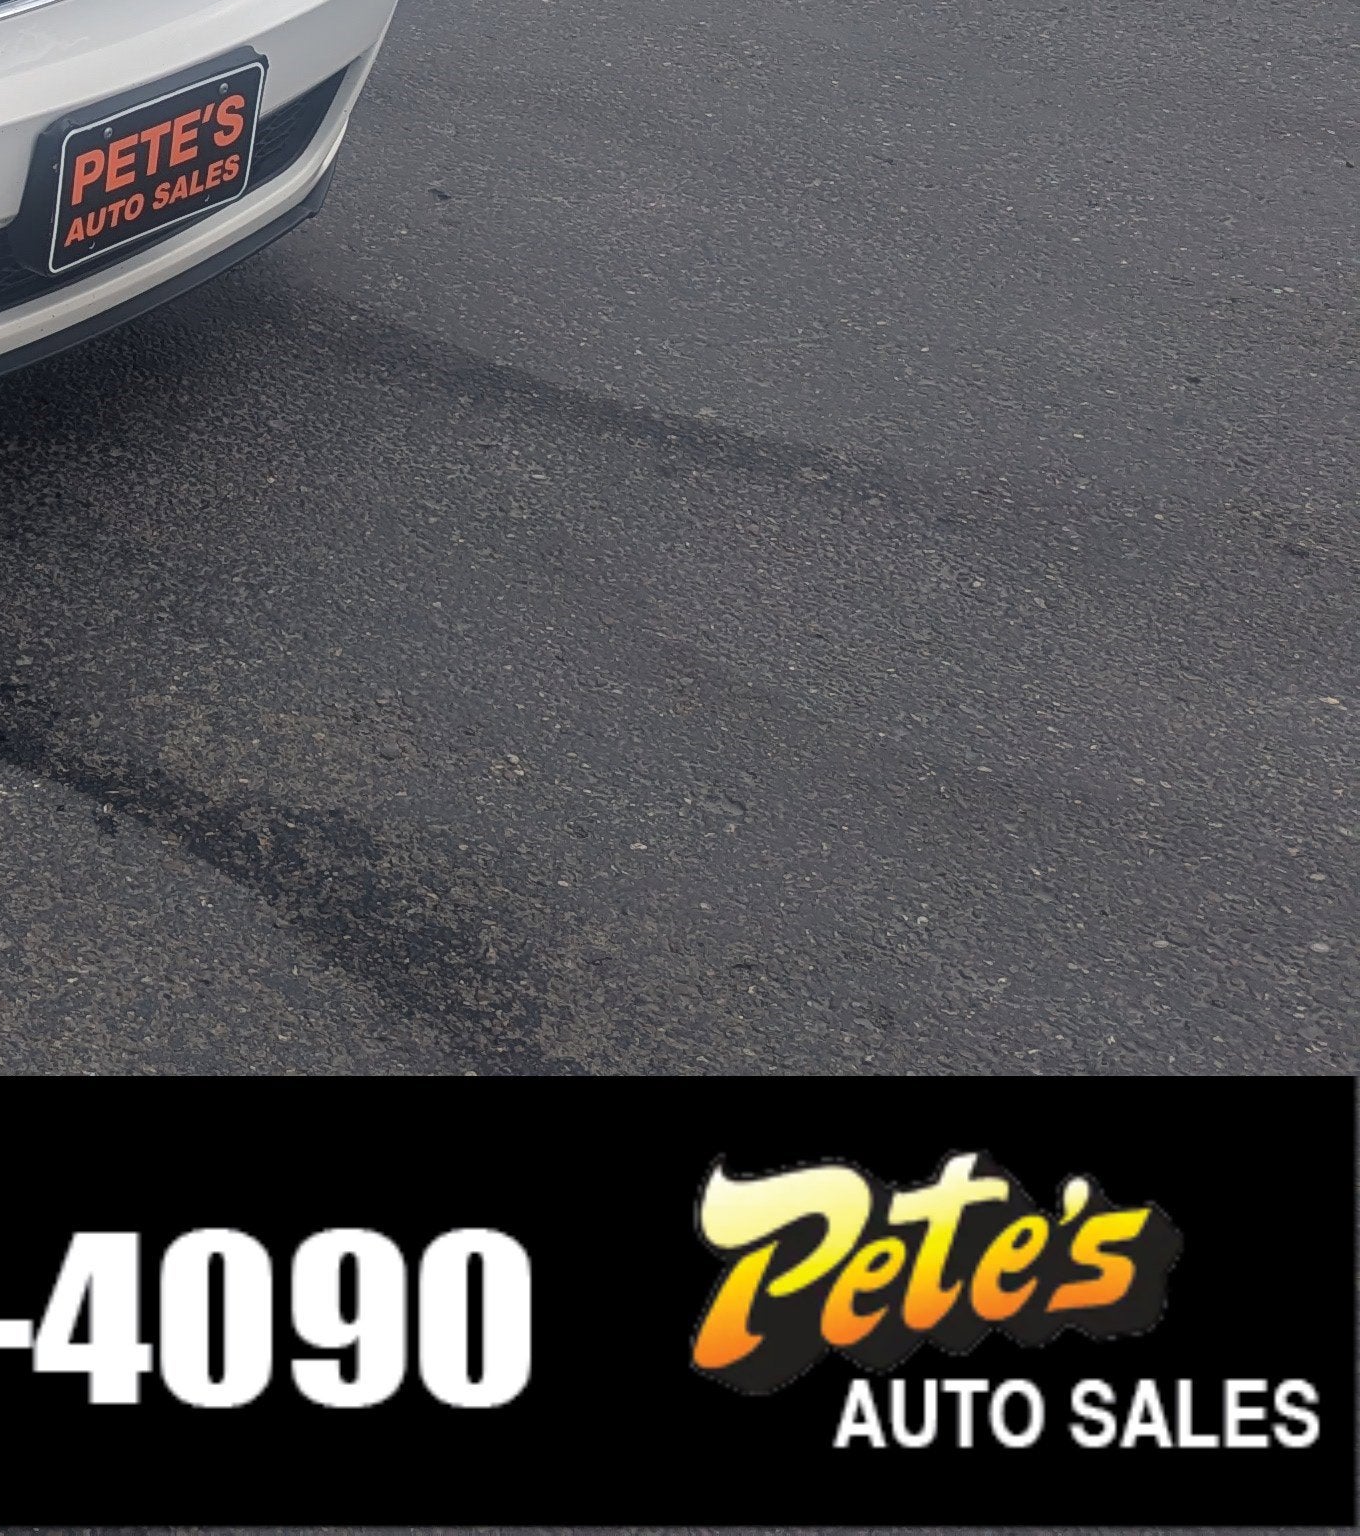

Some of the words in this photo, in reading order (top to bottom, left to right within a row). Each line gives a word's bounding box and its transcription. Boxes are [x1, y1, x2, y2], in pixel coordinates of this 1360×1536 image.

[63, 193, 146, 248] AUTO
[152, 154, 241, 210] SALES
[70, 94, 246, 206] PETE'S
